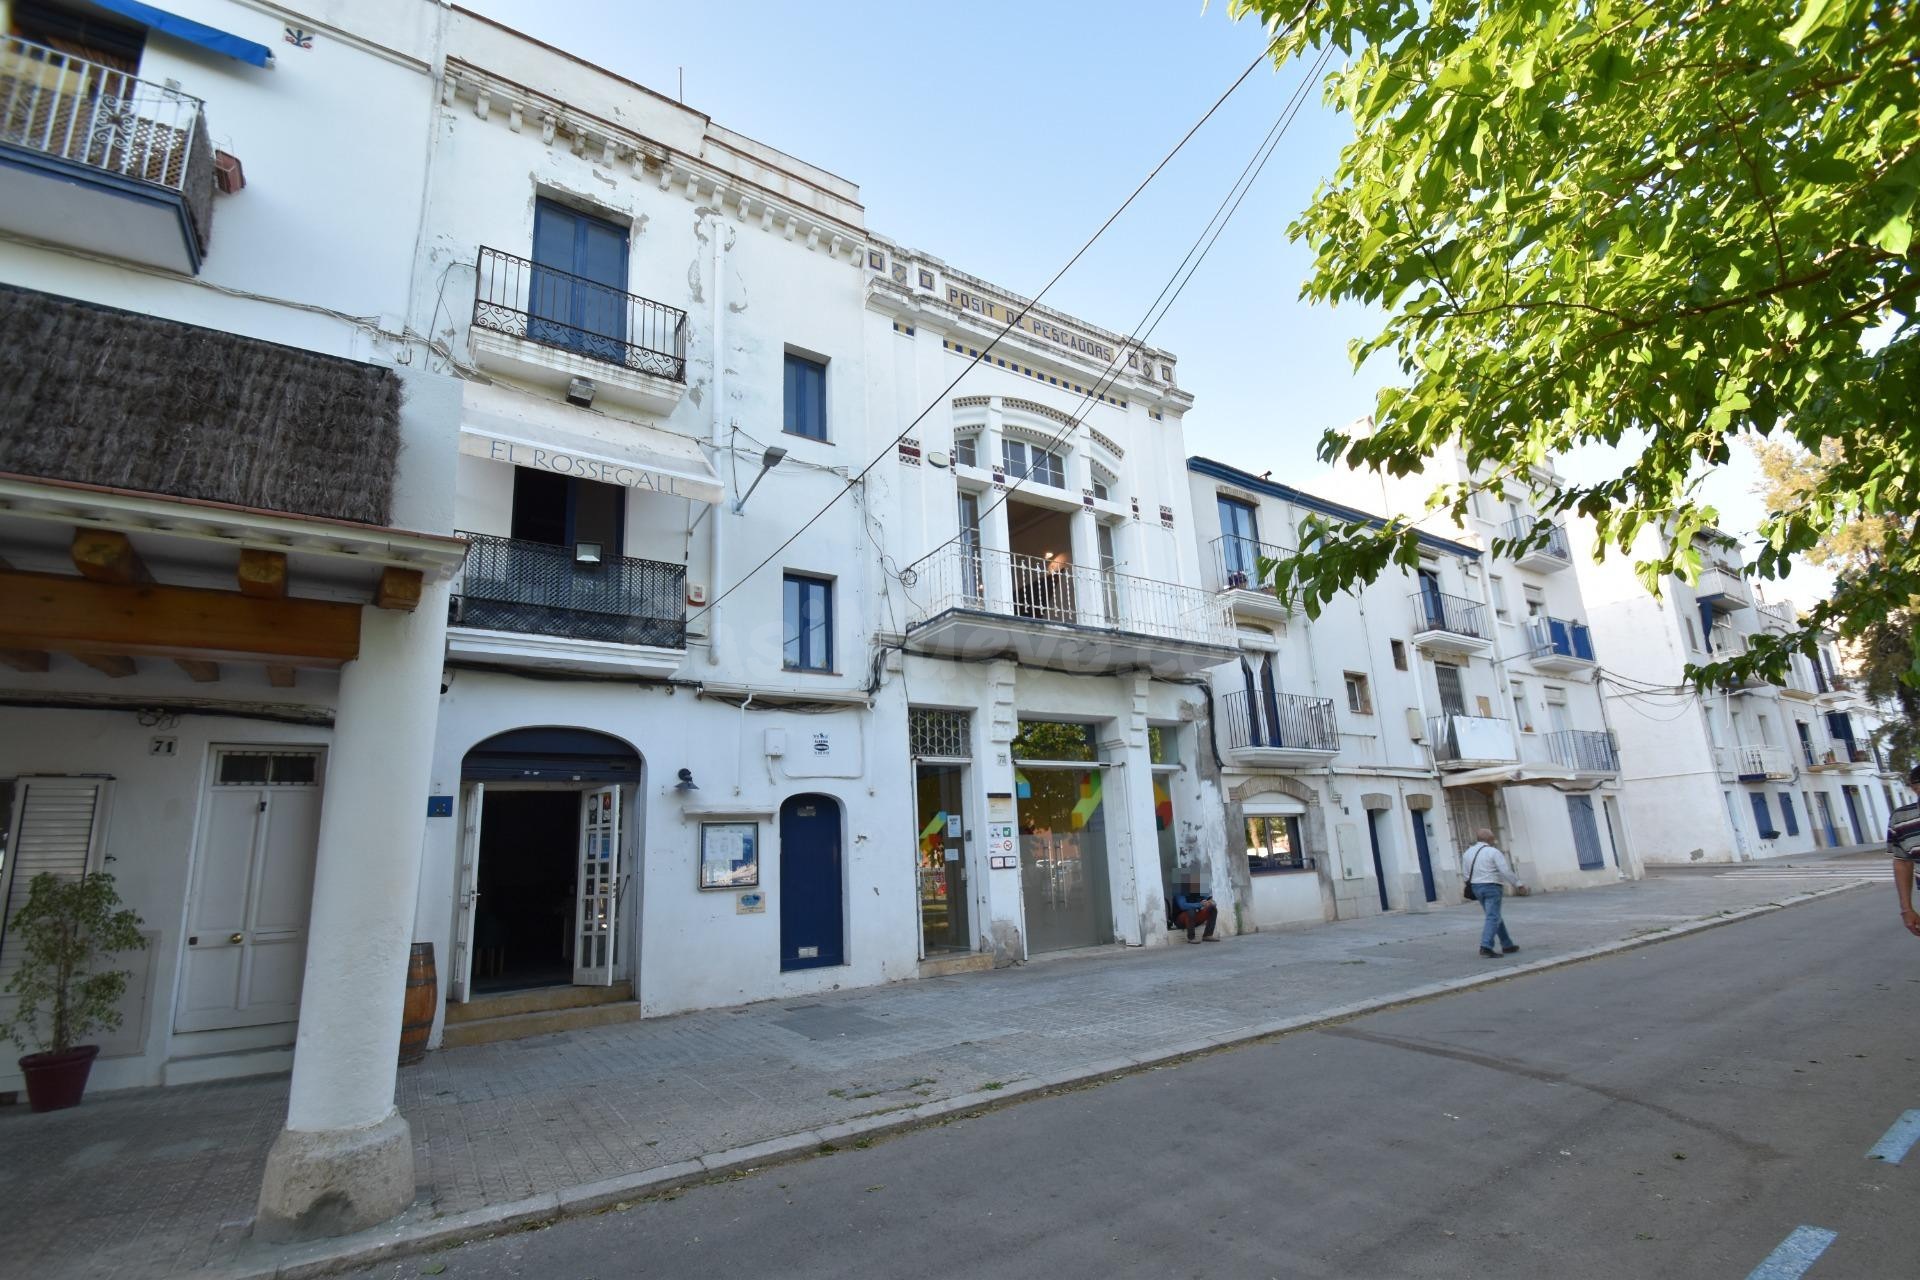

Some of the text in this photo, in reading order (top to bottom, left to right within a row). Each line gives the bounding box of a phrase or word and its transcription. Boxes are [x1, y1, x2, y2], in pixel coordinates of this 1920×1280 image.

[950, 288, 994, 318] POSIT
[1033, 320, 1112, 363] PESCADORS
[491, 440, 682, 497] EL ROSSEGALL
[154, 741, 173, 752] 71
